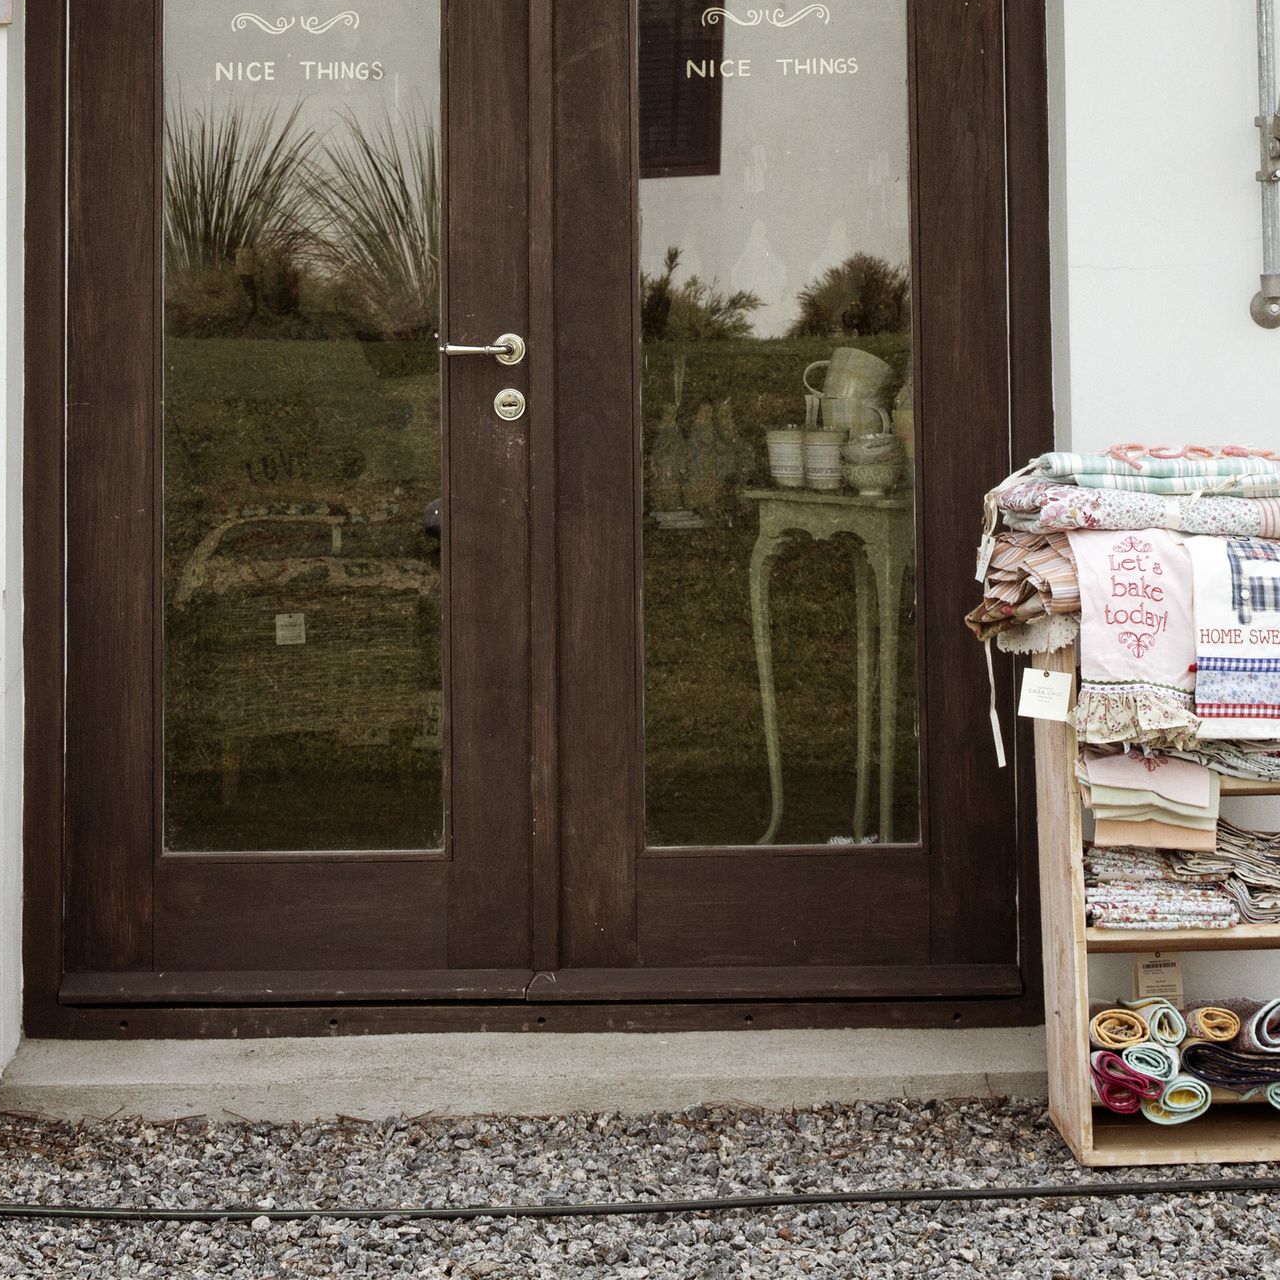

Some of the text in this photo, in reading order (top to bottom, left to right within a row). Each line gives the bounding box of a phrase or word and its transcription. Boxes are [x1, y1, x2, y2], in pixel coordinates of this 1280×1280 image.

[214, 60, 385, 82] NICE THINGS
[686, 57, 859, 79] NICE THINGS
[1110, 574, 1164, 602] bake
[1104, 601, 1169, 636] today!
[1199, 628, 1244, 645] HOME
